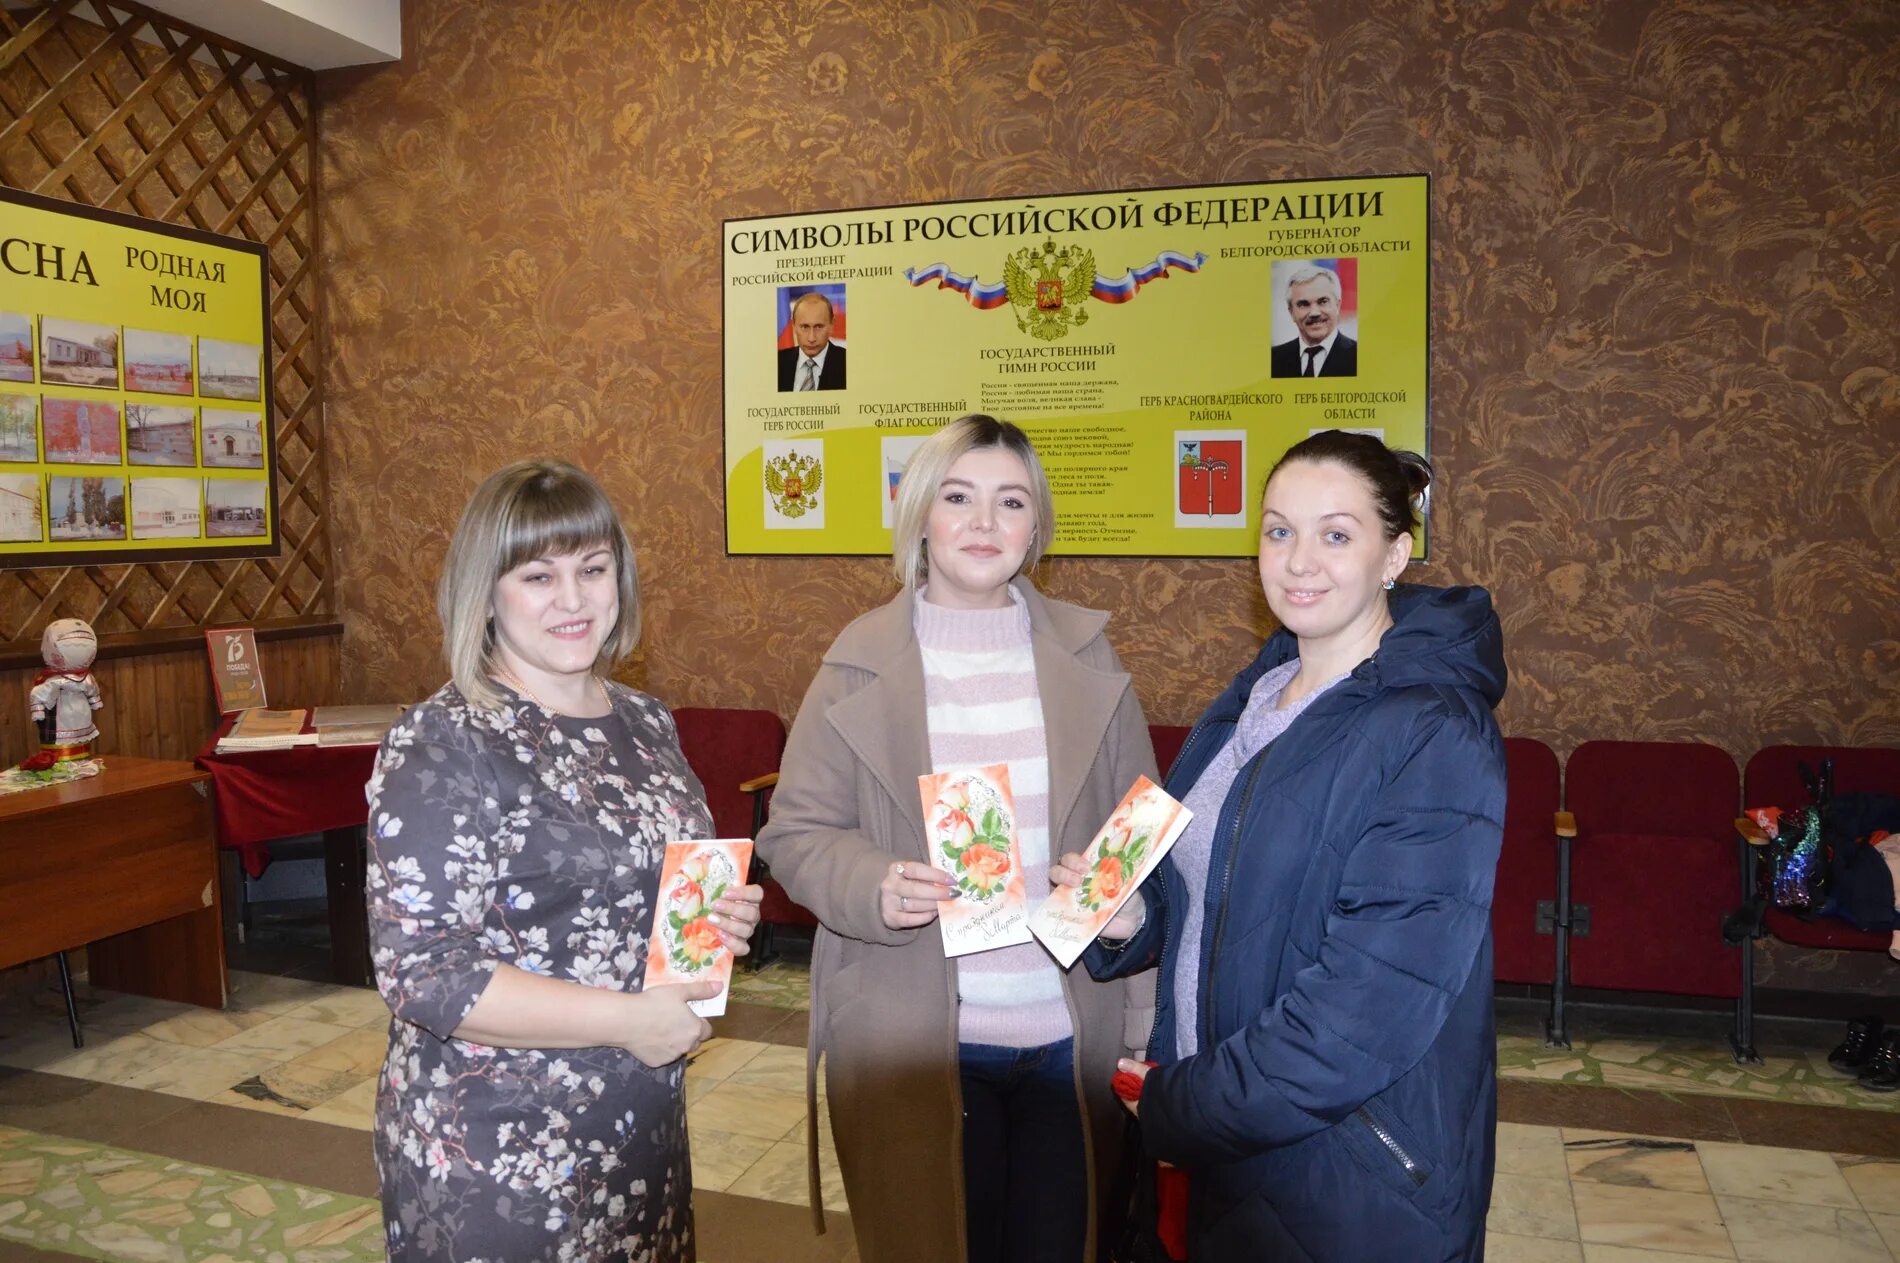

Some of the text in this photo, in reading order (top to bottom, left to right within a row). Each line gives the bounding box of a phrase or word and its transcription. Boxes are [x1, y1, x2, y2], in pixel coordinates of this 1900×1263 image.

[731, 191, 1384, 256] СИМВОЛЫ РОССИЙСКОЙ ФЕДЕРАЦИИ
[1268, 226, 1361, 242] ГУБЕРНАТОР
[1220, 240, 1411, 259] БЕЛГОРОДСКОЙ ОБЛАСТИ
[1, 238, 100, 287] СНА
[125, 245, 226, 283] РОДНАЯ
[776, 254, 846, 269] ПРЕЗИДЕНТ
[732, 265, 893, 286] РОССИЙСКОЙ ФЕДЕРАЦИИ
[151, 284, 207, 313] МОЯ
[980, 342, 1116, 360] ГОСУДАРСТВЕННЫЙ
[999, 360, 1096, 374] ГИМН РОССИИ
[1140, 391, 1283, 407] ГЕРБ КРАСНОГВАРДЕЙСКОГО
[1294, 389, 1407, 405] ГЕРБ БЕЛГОРОДСКОЙ
[747, 403, 841, 419] ГОСУДАРСТВЕННЫЙ
[859, 400, 967, 415] ГОСУДАРСТВЕННЫЙ
[1190, 408, 1232, 421] РАЙОНА
[1324, 407, 1376, 420] ОБЛАСТИ
[763, 419, 824, 431] ГЕРБ РОССИИ
[874, 416, 951, 429] ФЛАГ РОССИИ
